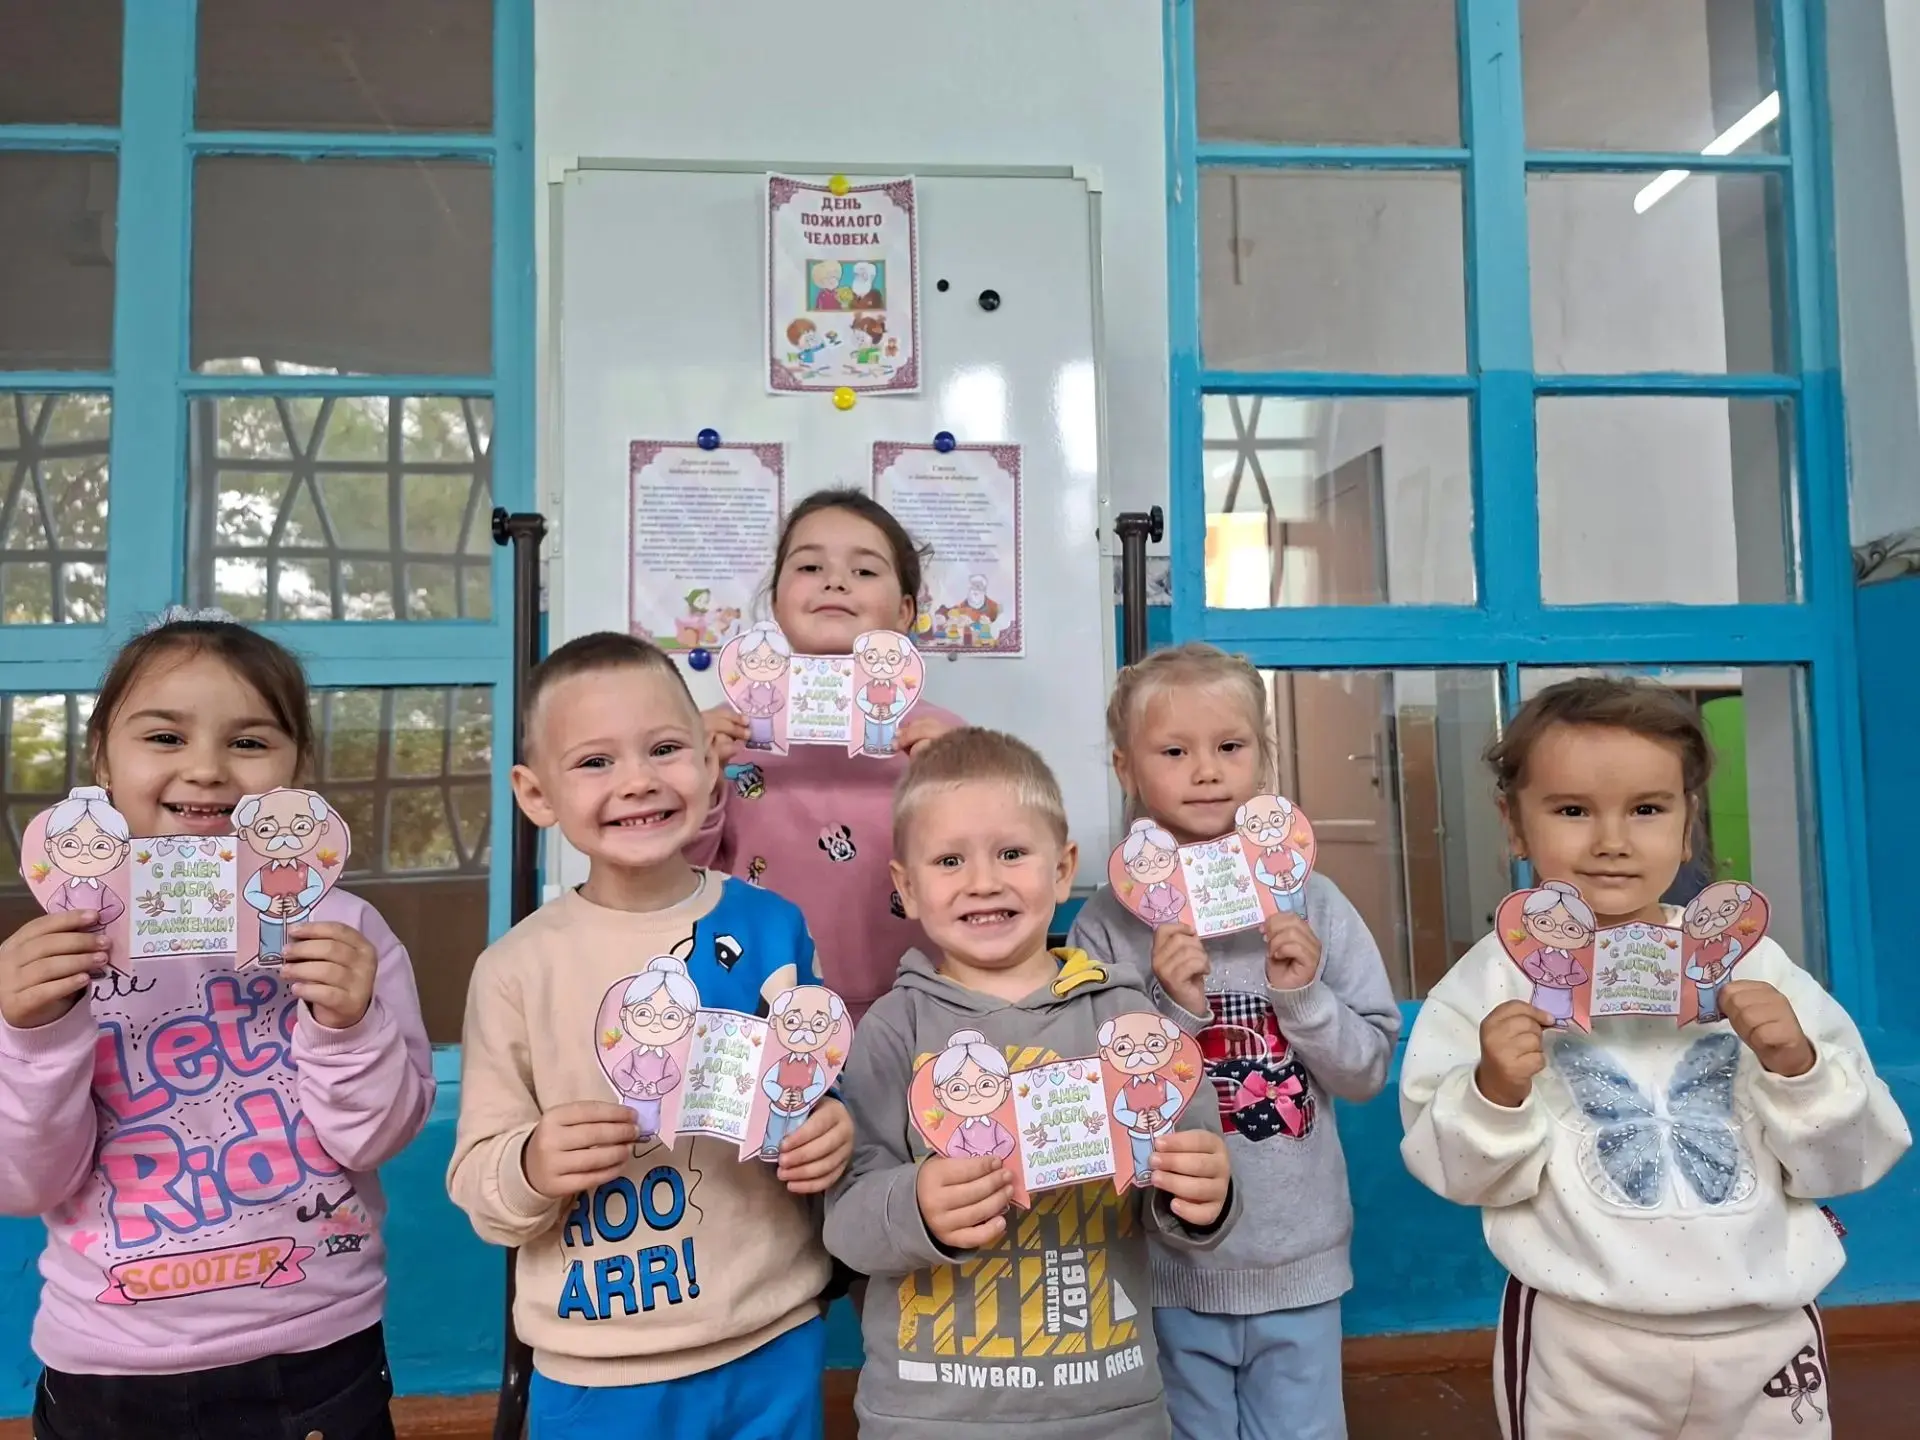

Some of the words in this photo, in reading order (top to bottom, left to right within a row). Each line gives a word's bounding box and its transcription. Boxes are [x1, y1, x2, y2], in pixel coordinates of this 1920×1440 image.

[821, 197, 862, 211] ДЕНЬ
[801, 213, 882, 228] ПОЖИЛОГО
[804, 231, 880, 246] ЧЕЛОВЕКА
[152, 862, 164, 878] С
[160, 881, 215, 898] ДОБРА
[180, 899, 192, 914] И
[136, 917, 234, 936] УВАЖЕНИЯ!
[1031, 1094, 1043, 1110] С
[1059, 1126, 1071, 1142] И
[1027, 1137, 1110, 1169] УВАЖЕНИЯ!
[122, 1246, 282, 1295] SCOOTER
[558, 1237, 700, 1320] ARR!
[1045, 1250, 1060, 1333] ELEVATION
[1061, 1248, 1088, 1329] 1987
[940, 1363, 1045, 1389] SNWBRD.
[1053, 1360, 1099, 1386] RUN
[1105, 1345, 1145, 1378] AREA
